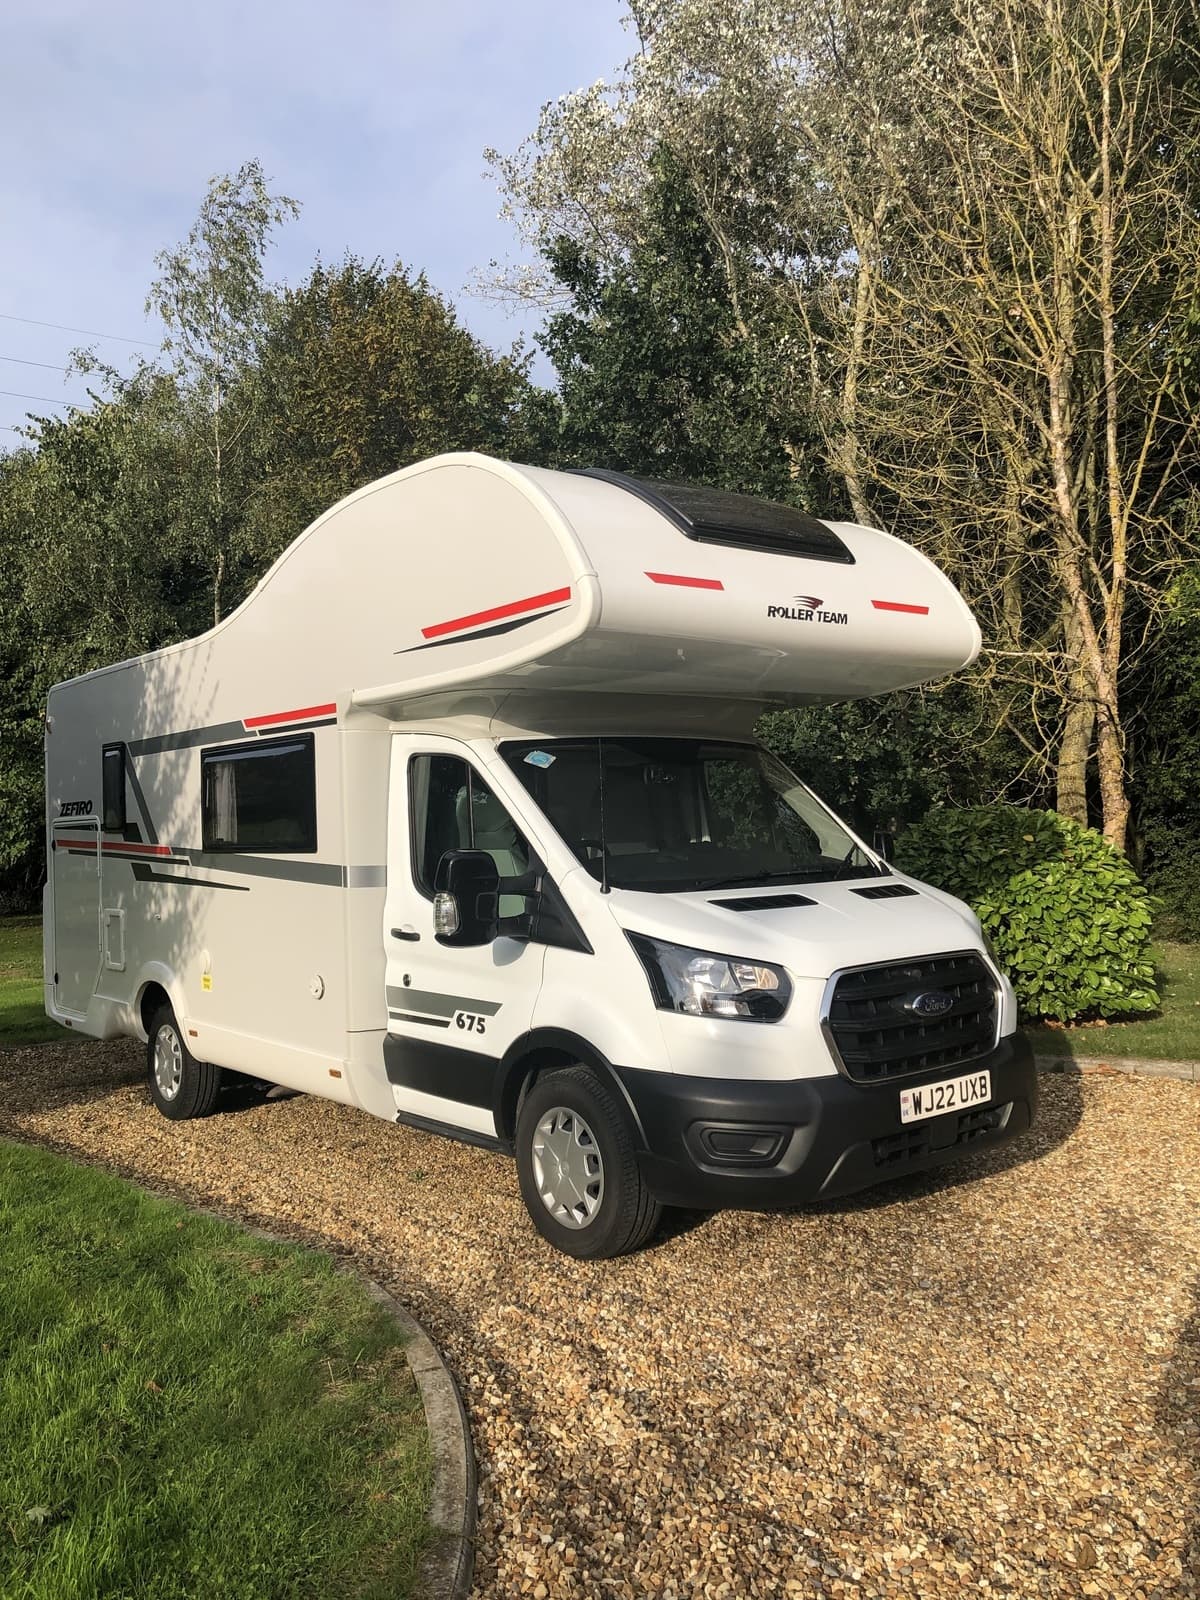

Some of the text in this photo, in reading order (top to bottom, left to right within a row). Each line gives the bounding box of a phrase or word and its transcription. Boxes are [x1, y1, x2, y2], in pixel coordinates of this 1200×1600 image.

[767, 605, 848, 625] ROLLER TEAM
[60, 800, 93, 817] ZEFIRO
[919, 997, 947, 1012] Ford
[456, 1012, 486, 1035] 675
[912, 1075, 988, 1116] WJ22 UXB
